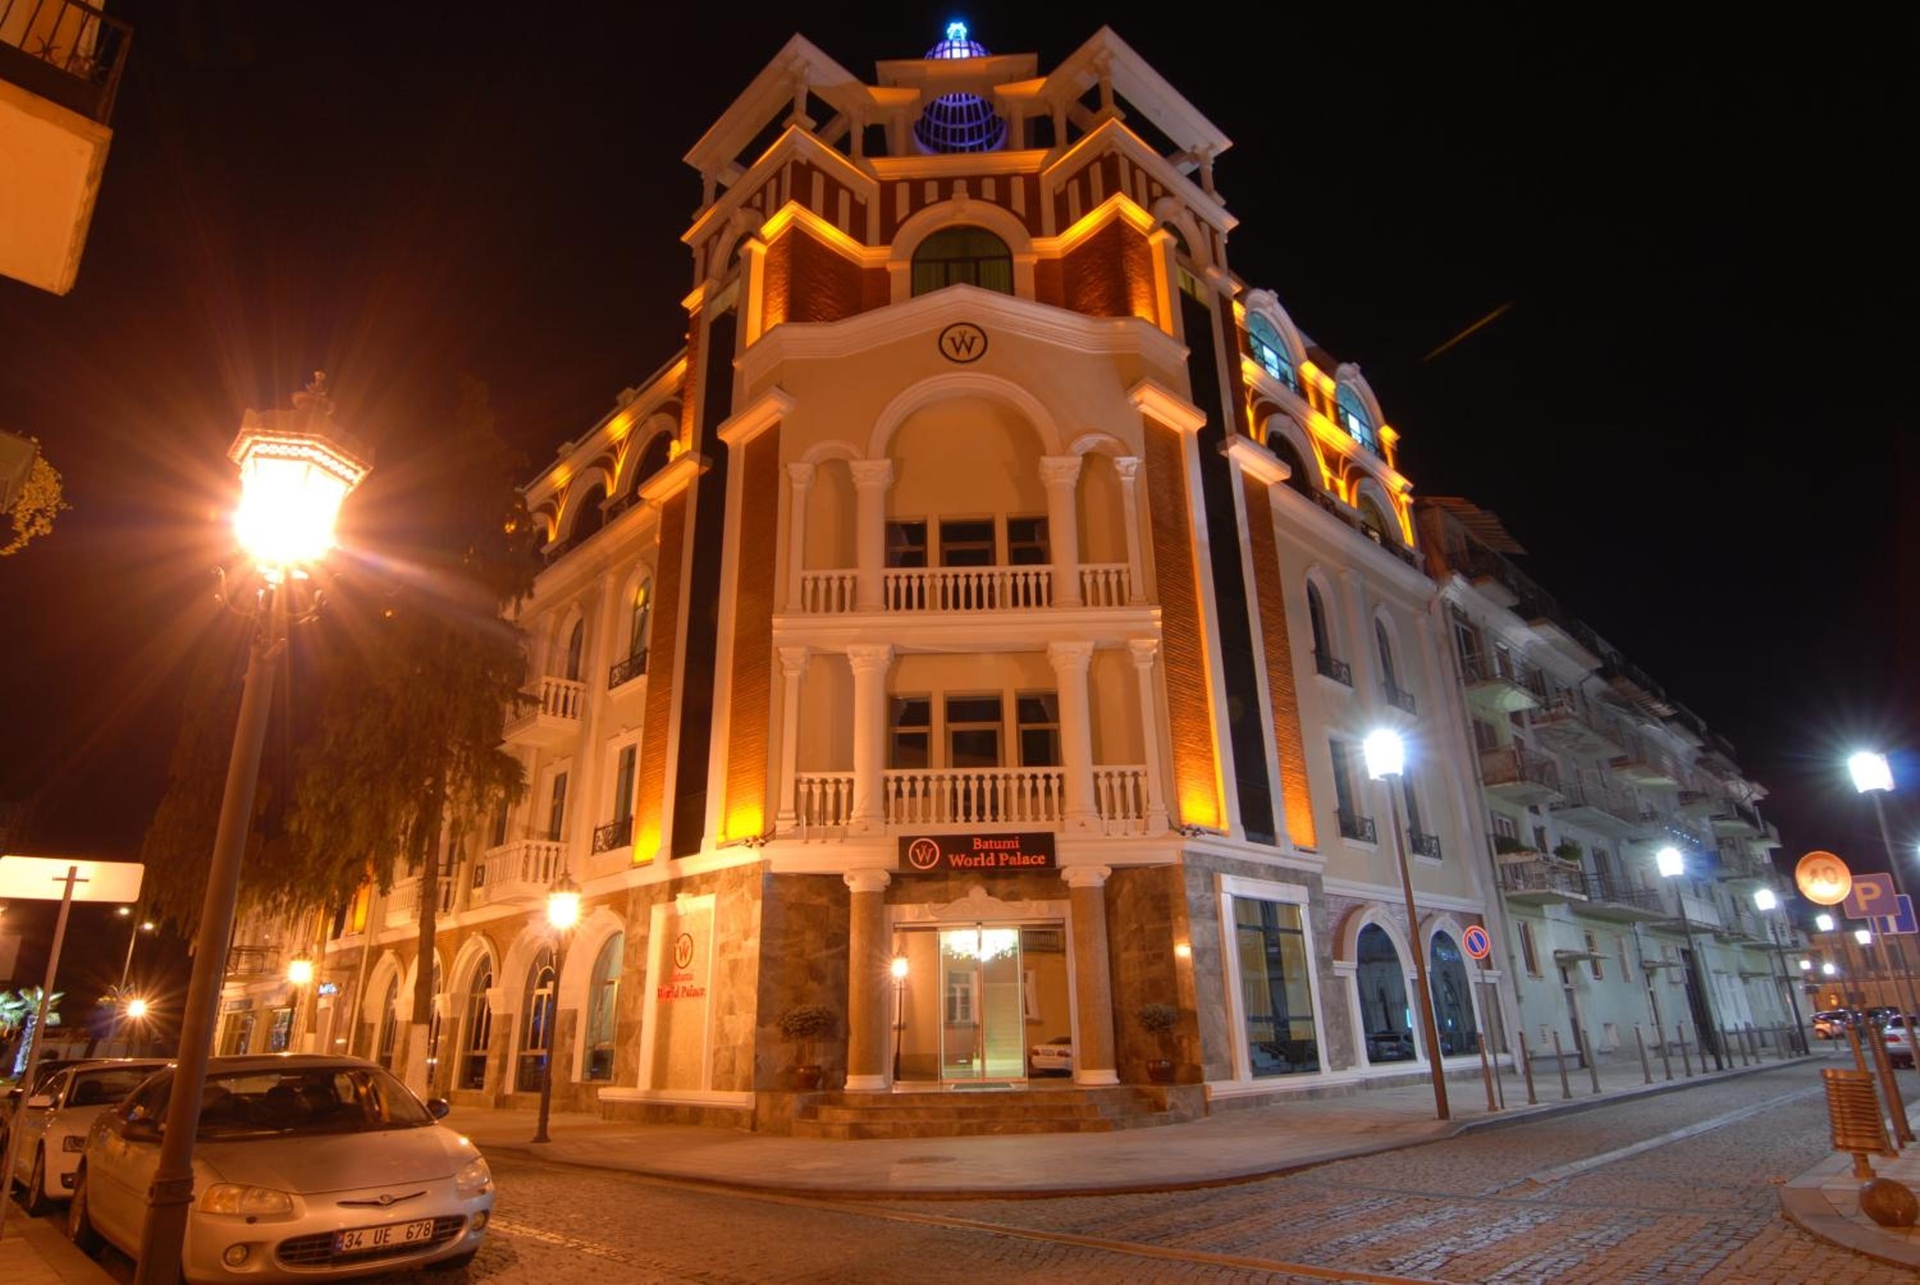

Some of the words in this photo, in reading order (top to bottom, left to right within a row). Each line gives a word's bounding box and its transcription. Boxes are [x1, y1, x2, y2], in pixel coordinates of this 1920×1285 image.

[972, 837, 1020, 850] Batumi
[948, 853, 995, 868] World
[999, 852, 1046, 867] Palace
[1853, 881, 1882, 911] P
[344, 1231, 363, 1249] 34
[373, 1227, 391, 1245] UE
[405, 1220, 432, 1241] 678
